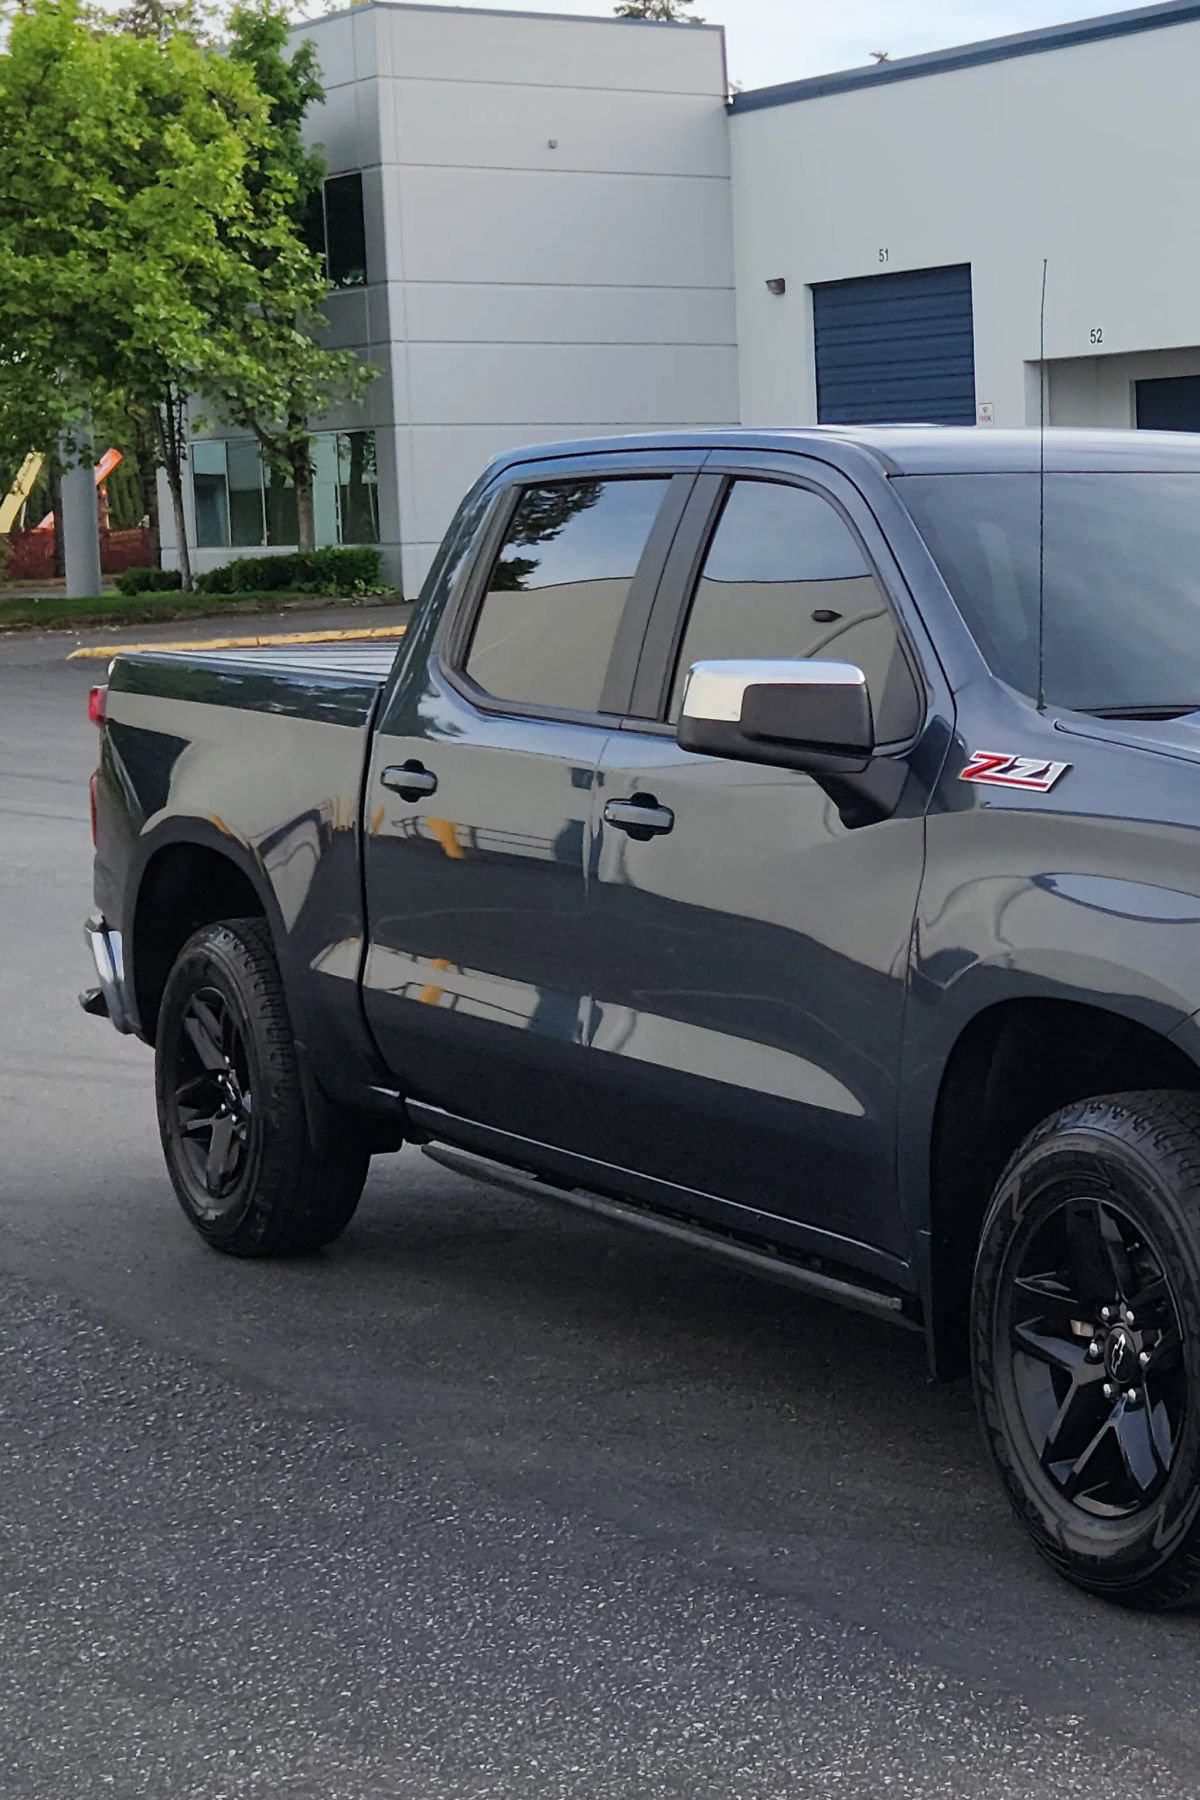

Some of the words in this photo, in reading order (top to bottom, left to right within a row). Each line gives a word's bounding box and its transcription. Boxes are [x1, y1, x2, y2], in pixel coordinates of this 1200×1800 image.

[879, 248, 889, 263] 51
[1089, 328, 1103, 344] 52
[959, 750, 1073, 793] Z71
